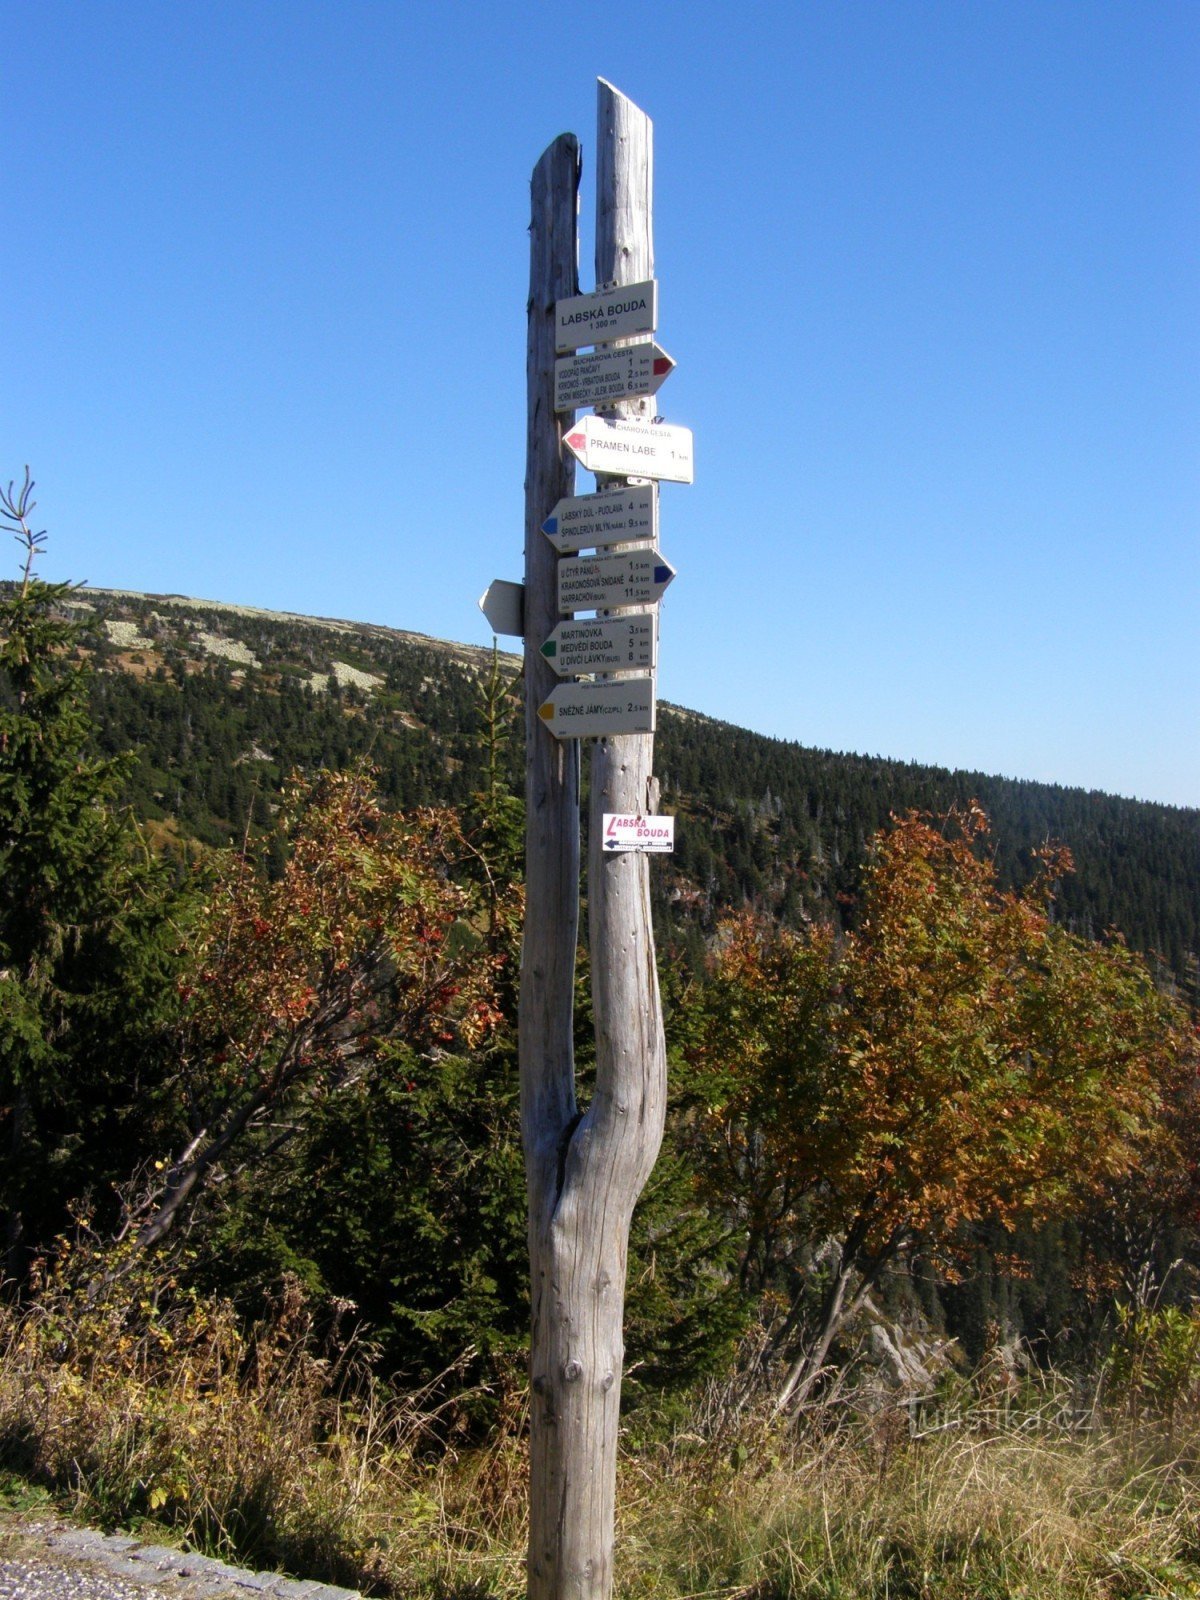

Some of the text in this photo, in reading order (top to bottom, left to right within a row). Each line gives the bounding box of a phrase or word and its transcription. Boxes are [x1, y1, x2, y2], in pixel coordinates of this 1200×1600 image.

[562, 299, 646, 326] LABSKÁ BOUDA
[613, 349, 633, 358] CESTA
[628, 358, 633, 366] 1
[650, 429, 672, 437] CESTA
[590, 438, 630, 453] PRAMEN
[632, 445, 656, 456] LABE
[670, 450, 675, 459] 1
[561, 629, 602, 640] MARTINOVKA
[590, 640, 613, 650] BOUDA
[629, 639, 634, 648] 5
[560, 658, 564, 666] U
[559, 705, 584, 716] SNĚŽNÉ
[637, 829, 669, 837] BOUDA
